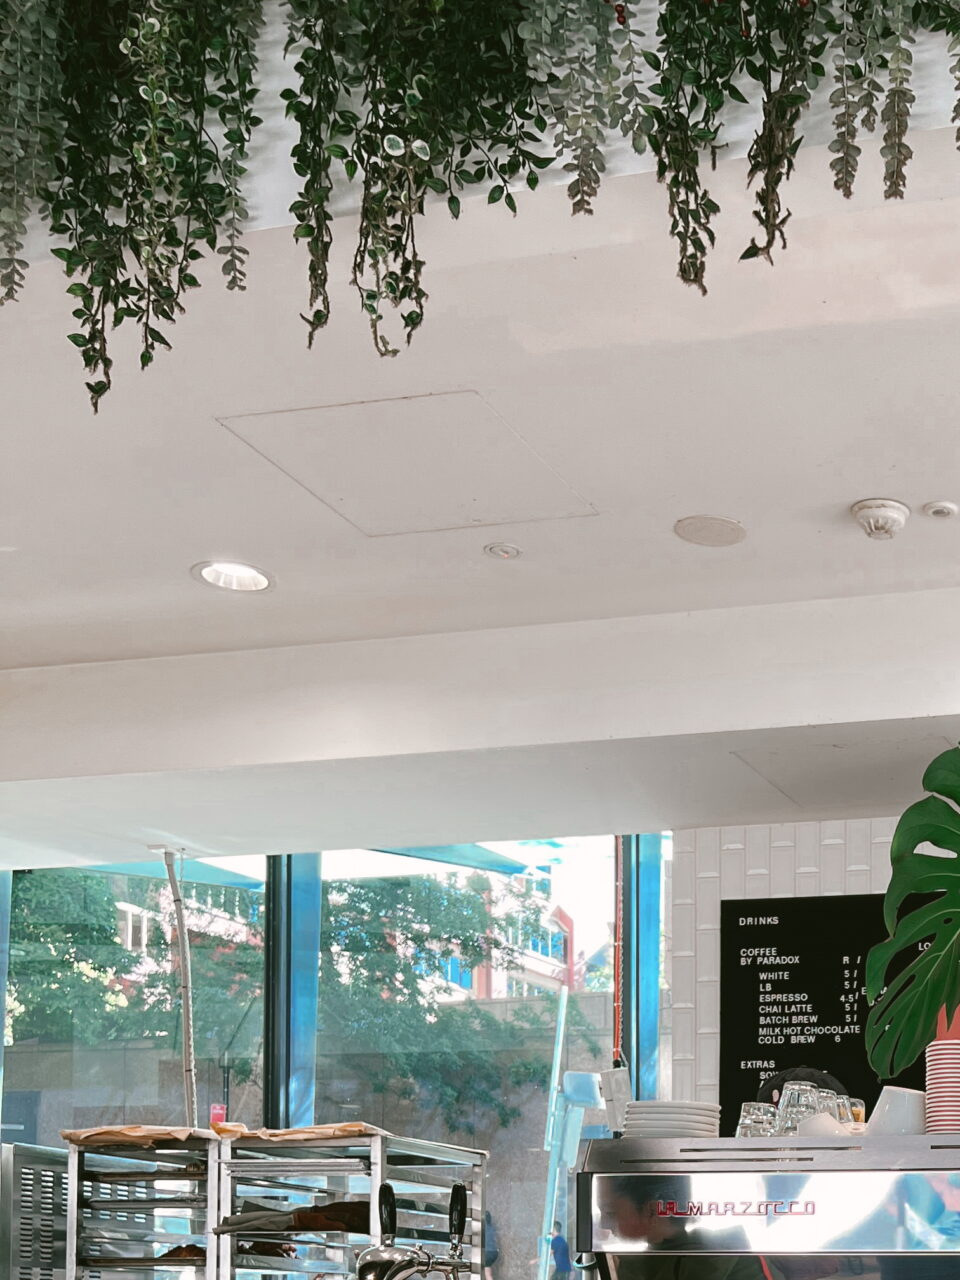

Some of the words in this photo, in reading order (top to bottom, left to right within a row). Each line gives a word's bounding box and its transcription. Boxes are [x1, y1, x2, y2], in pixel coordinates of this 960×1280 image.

[739, 916, 779, 926] DRINKS
[740, 947, 778, 956] COFFEE
[740, 957, 752, 966] BY
[757, 956, 800, 965] PARADOX
[759, 971, 790, 980] WHITE
[759, 983, 772, 992] LB
[759, 993, 808, 1002] ESPRESSO
[759, 1005, 782, 1014] CHAI
[785, 1004, 813, 1013] LATTE
[759, 1016, 789, 1025] BATCH
[791, 1015, 818, 1024] BREW
[758, 1027, 781, 1036] MILK
[783, 1027, 802, 1035] HOT
[804, 1025, 861, 1034] CHOCOLATE
[790, 1035, 816, 1044] BREW
[834, 1035, 841, 1043] 6
[740, 1060, 776, 1069] EXTRAS
